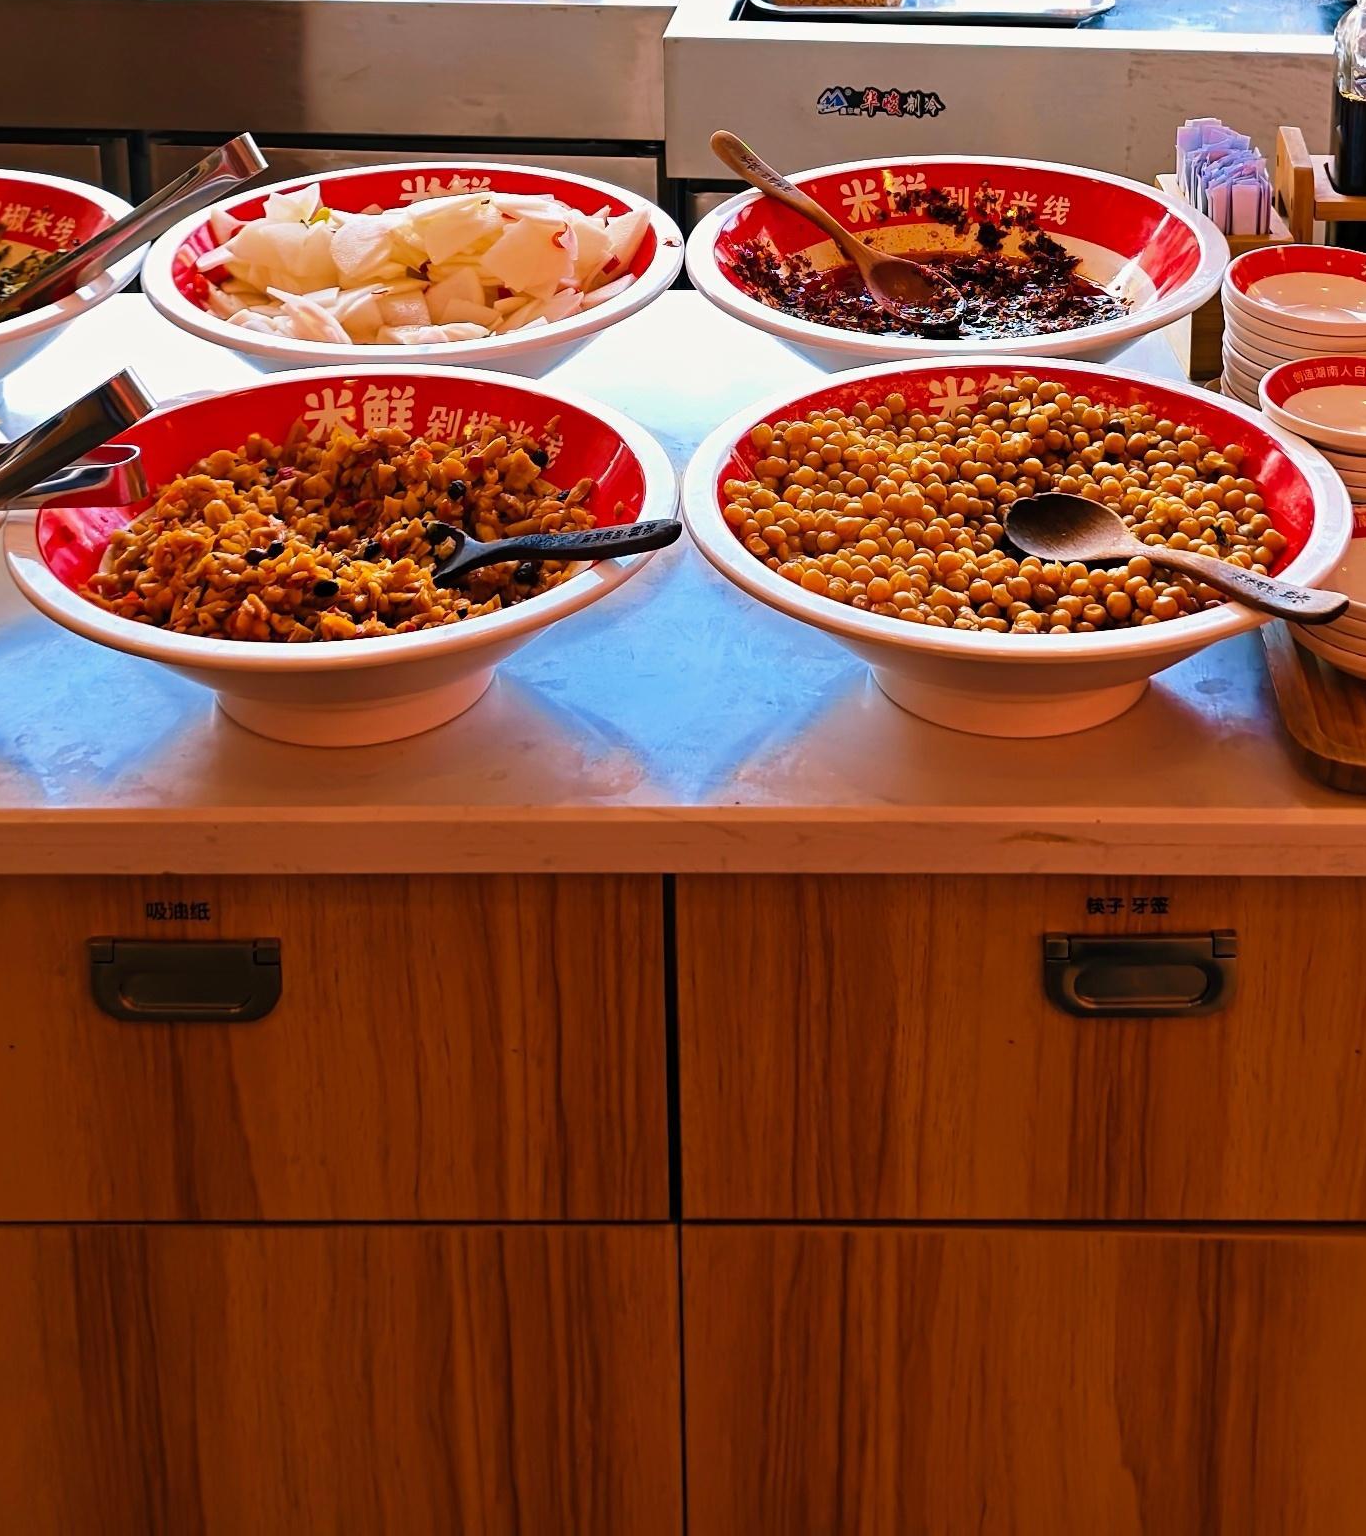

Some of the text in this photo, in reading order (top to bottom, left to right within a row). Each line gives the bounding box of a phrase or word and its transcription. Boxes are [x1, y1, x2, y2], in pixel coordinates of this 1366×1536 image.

[304, 384, 416, 442] 米鲜
[145, 902, 212, 921] 吸油纸
[1086, 896, 1170, 914] 筷子 牙签
